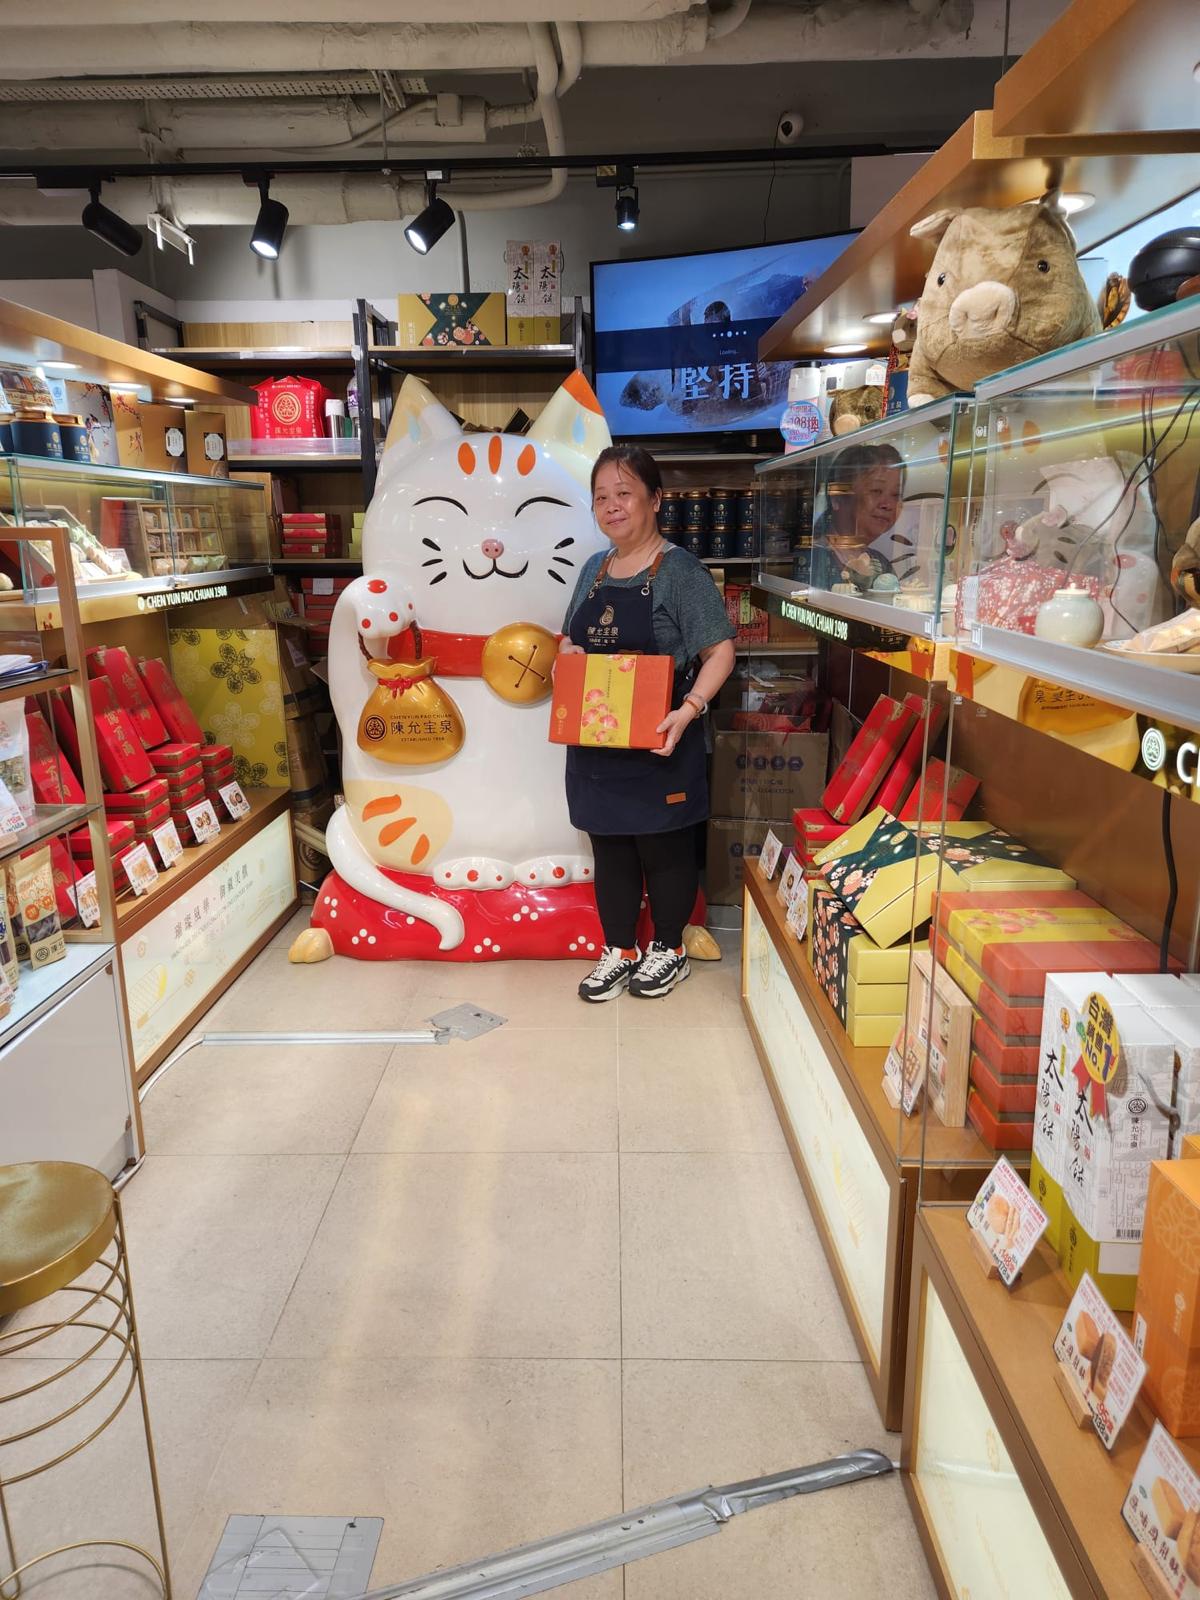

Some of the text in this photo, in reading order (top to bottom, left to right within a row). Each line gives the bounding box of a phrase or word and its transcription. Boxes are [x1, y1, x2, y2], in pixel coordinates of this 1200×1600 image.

[681, 363, 755, 400] 堅持
[146, 594, 166, 608] CHEN
[166, 591, 180, 606] YUN
[181, 590, 194, 603] PAO
[194, 587, 214, 601] CHUAN
[785, 603, 797, 620] CHEN
[806, 609, 816, 628] PAO
[816, 613, 834, 635] CHUAN
[390, 720, 453, 735] 陳允宝泉
